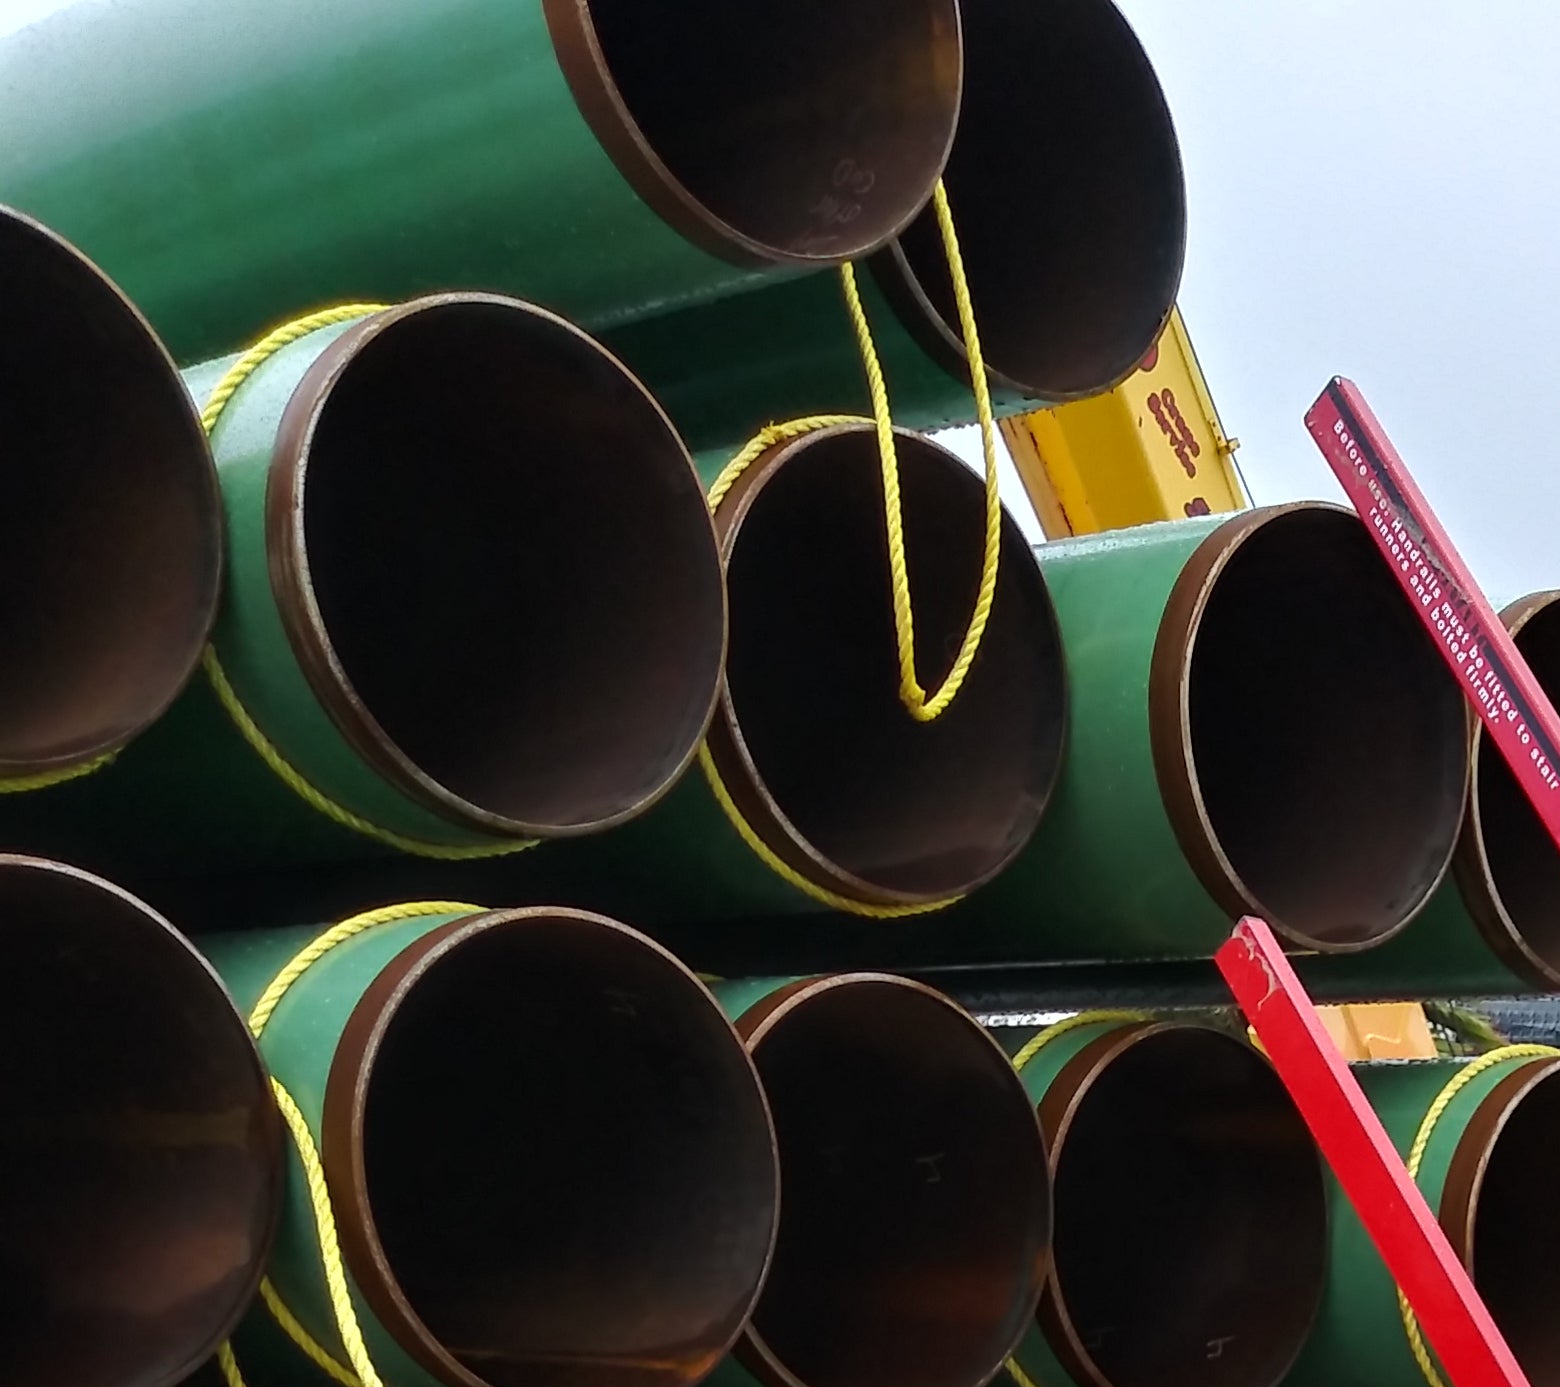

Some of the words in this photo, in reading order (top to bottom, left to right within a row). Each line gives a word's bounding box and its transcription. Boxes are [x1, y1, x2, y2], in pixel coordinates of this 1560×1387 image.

[1368, 507, 1410, 571] runners
[1409, 574, 1431, 606] and
[1430, 608, 1466, 663] bolted
[1389, 518, 1443, 599] Handrails
[1441, 602, 1469, 644] must
[1468, 645, 1485, 670] be
[1483, 671, 1517, 722] fitted
[1515, 723, 1530, 745] to
[1530, 747, 1559, 790] stair
